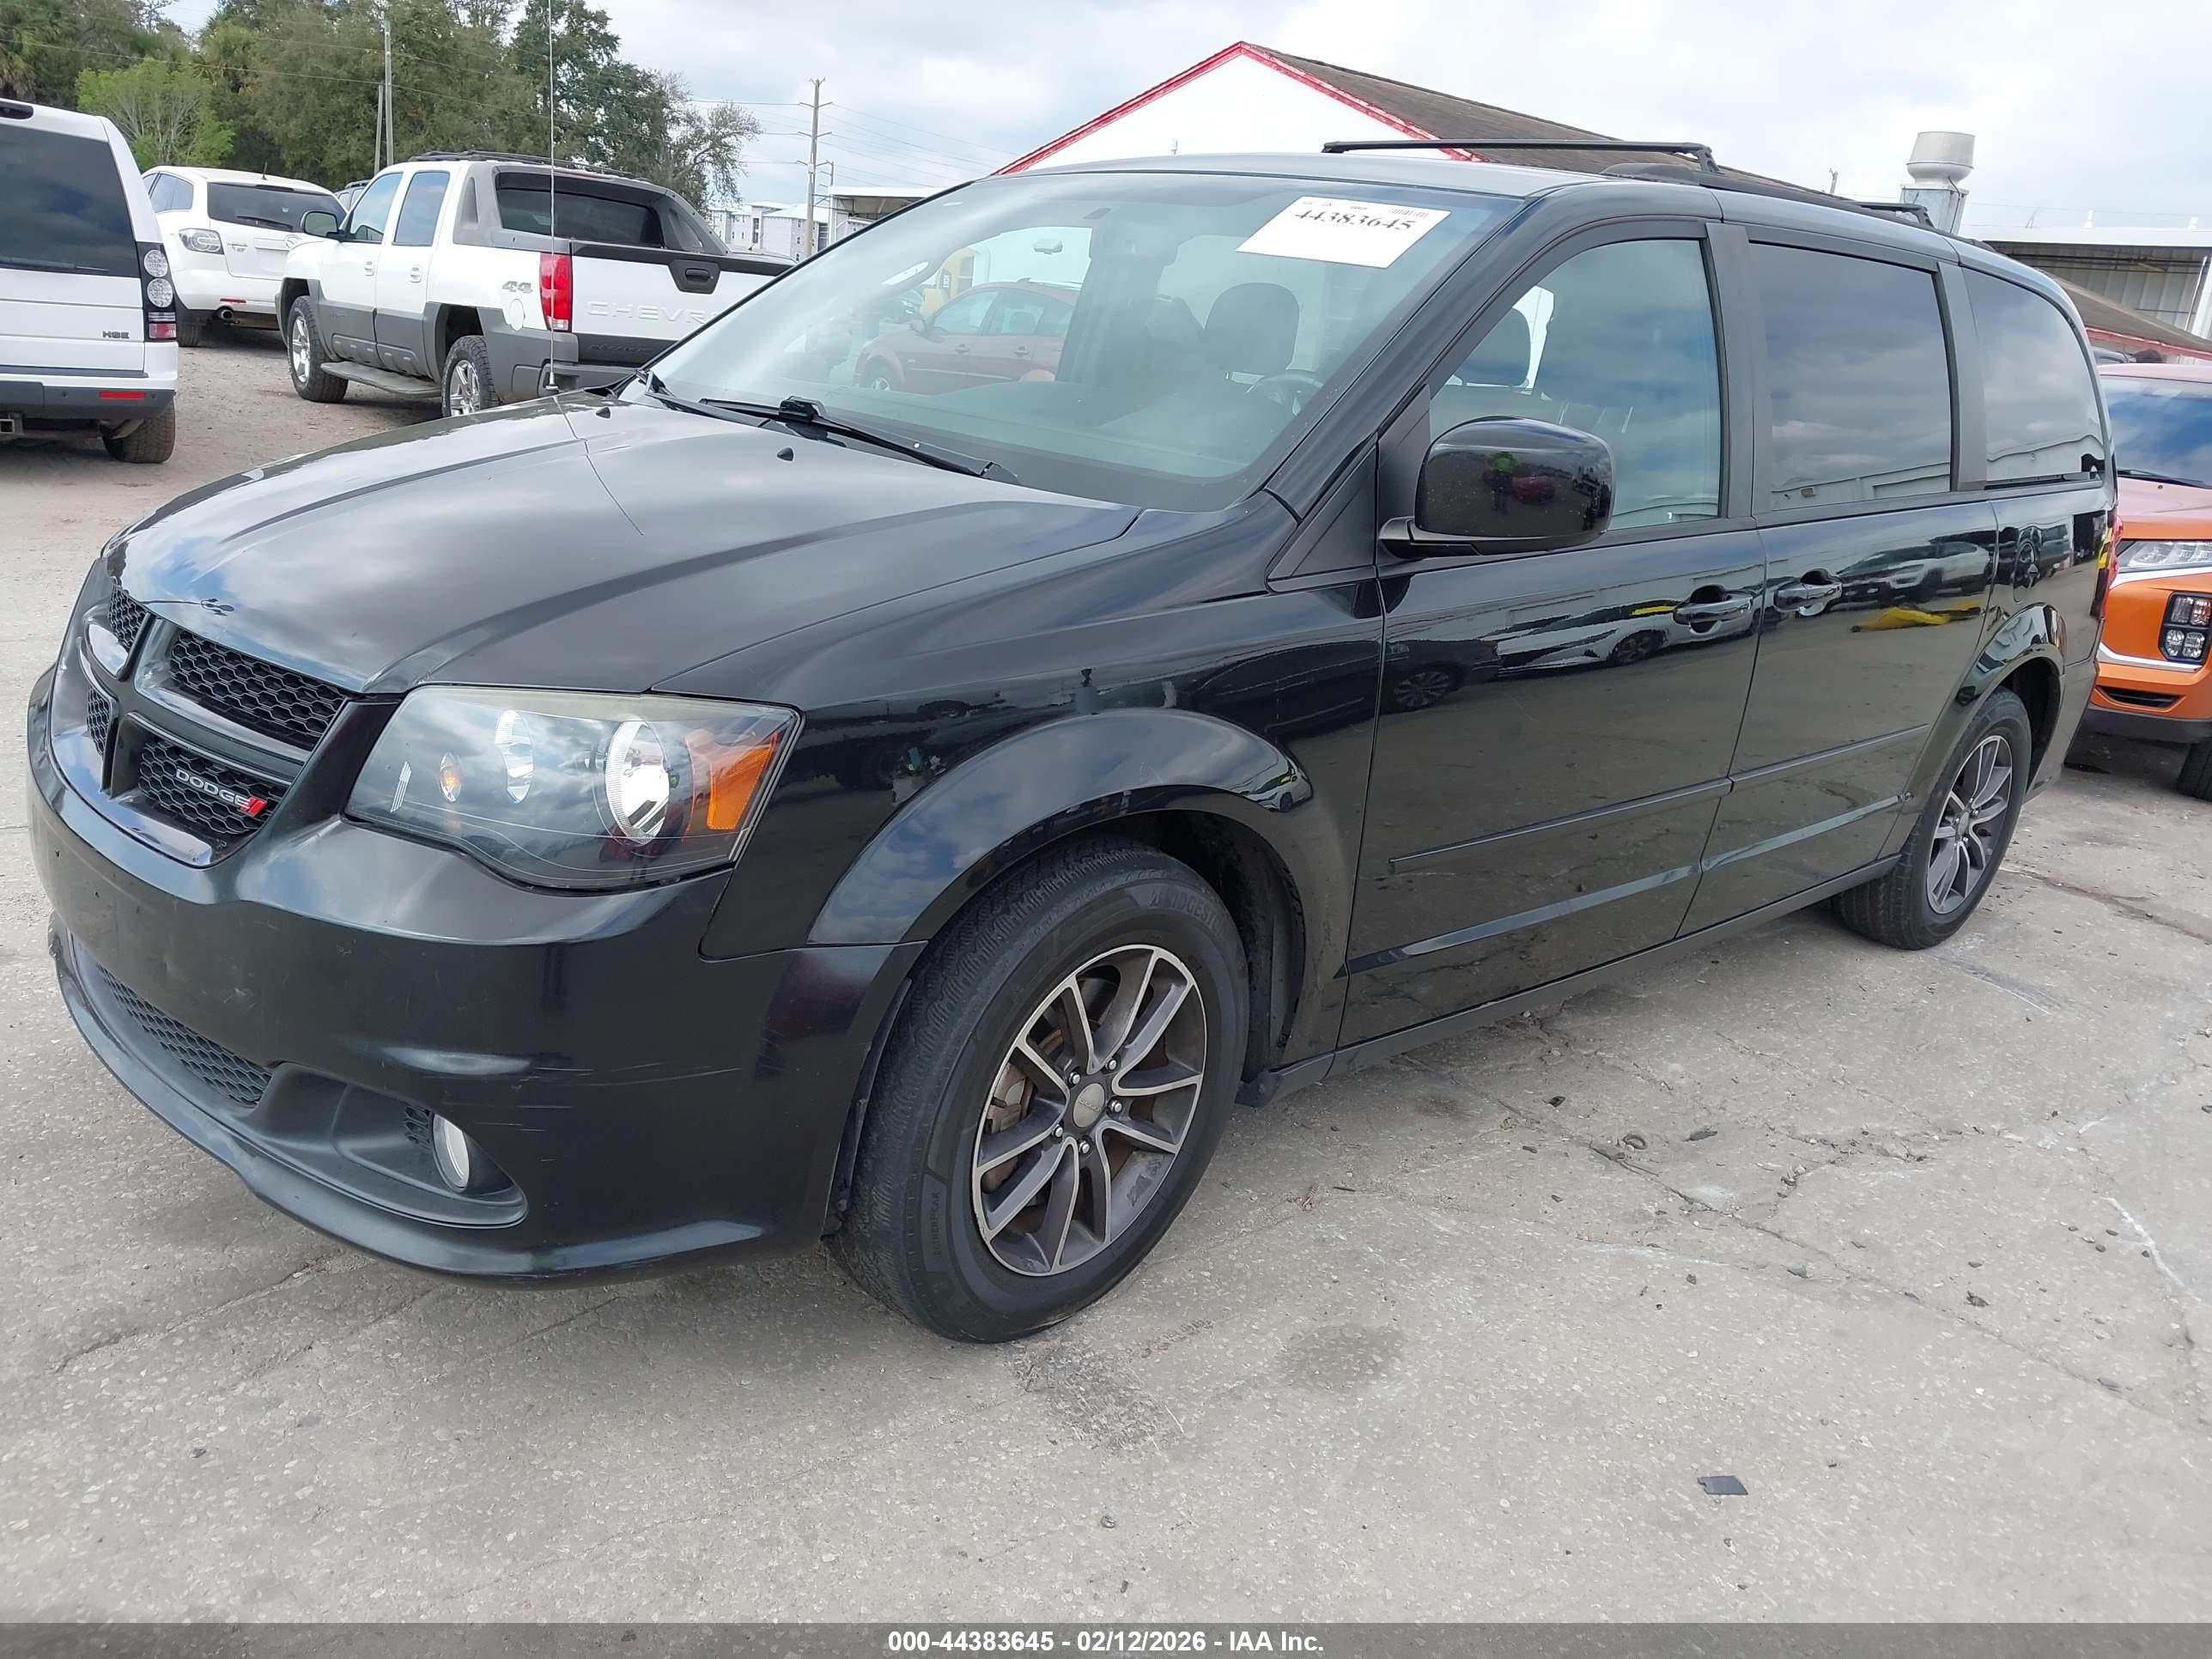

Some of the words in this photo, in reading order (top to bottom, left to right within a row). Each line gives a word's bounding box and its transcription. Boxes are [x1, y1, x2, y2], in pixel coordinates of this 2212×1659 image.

[1295, 210, 1416, 230] 44383645
[501, 281, 533, 294] 44
[176, 769, 251, 809] DODGE
